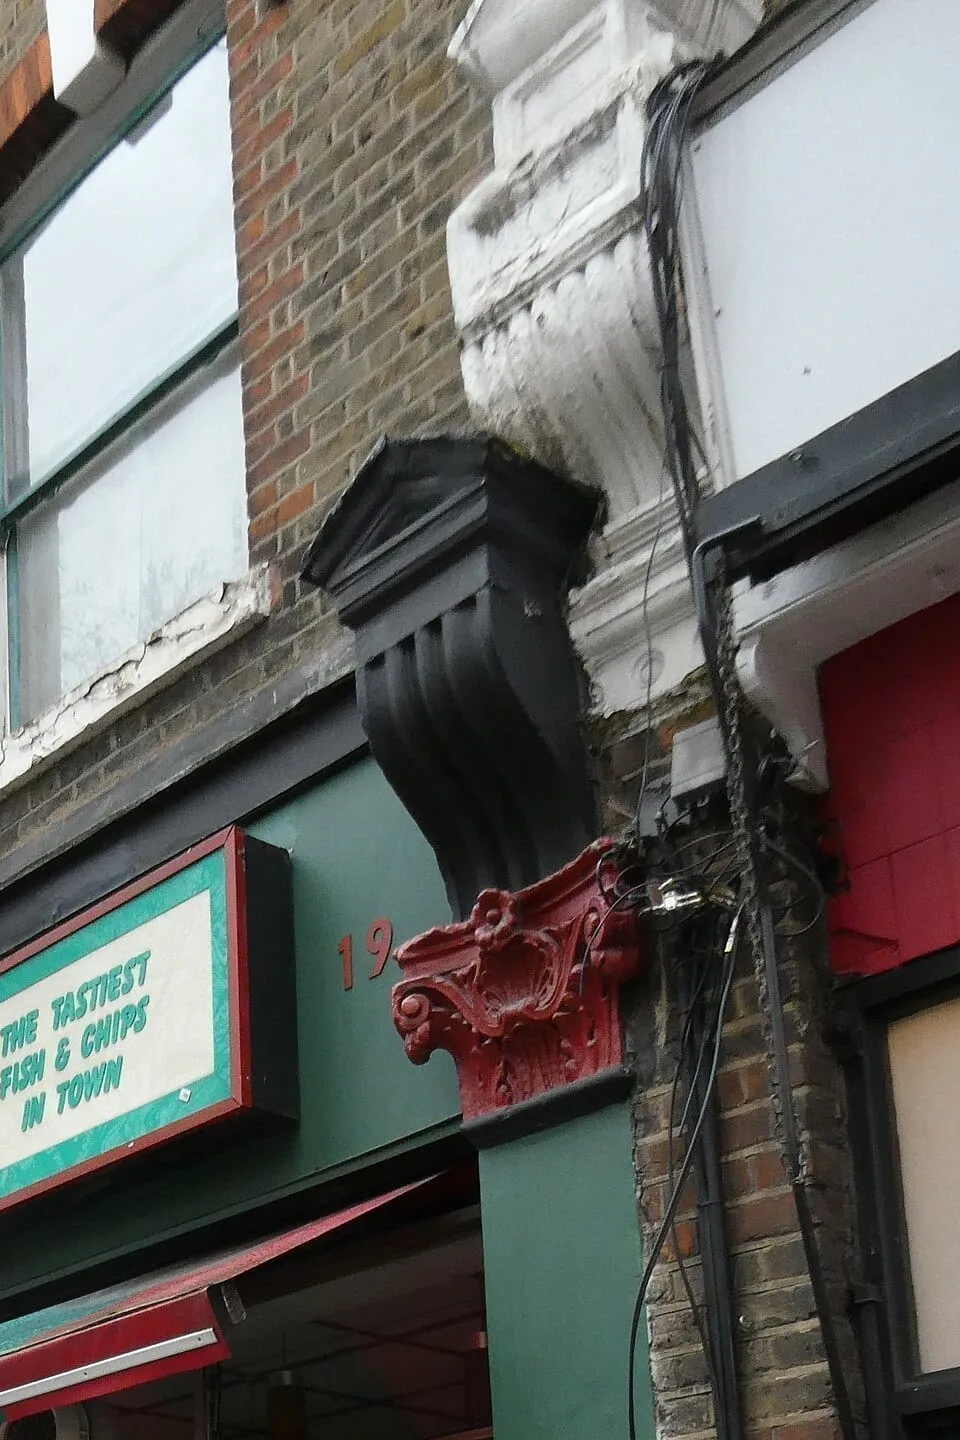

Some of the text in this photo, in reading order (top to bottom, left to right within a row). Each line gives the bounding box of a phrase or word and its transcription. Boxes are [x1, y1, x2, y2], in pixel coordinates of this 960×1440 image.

[50, 949, 152, 1028] TASTIEST
[336, 916, 395, 991] 19
[54, 1037, 71, 1073] &
[80, 995, 151, 1061] CHIPS
[20, 1056, 123, 1133] IN TOWN
